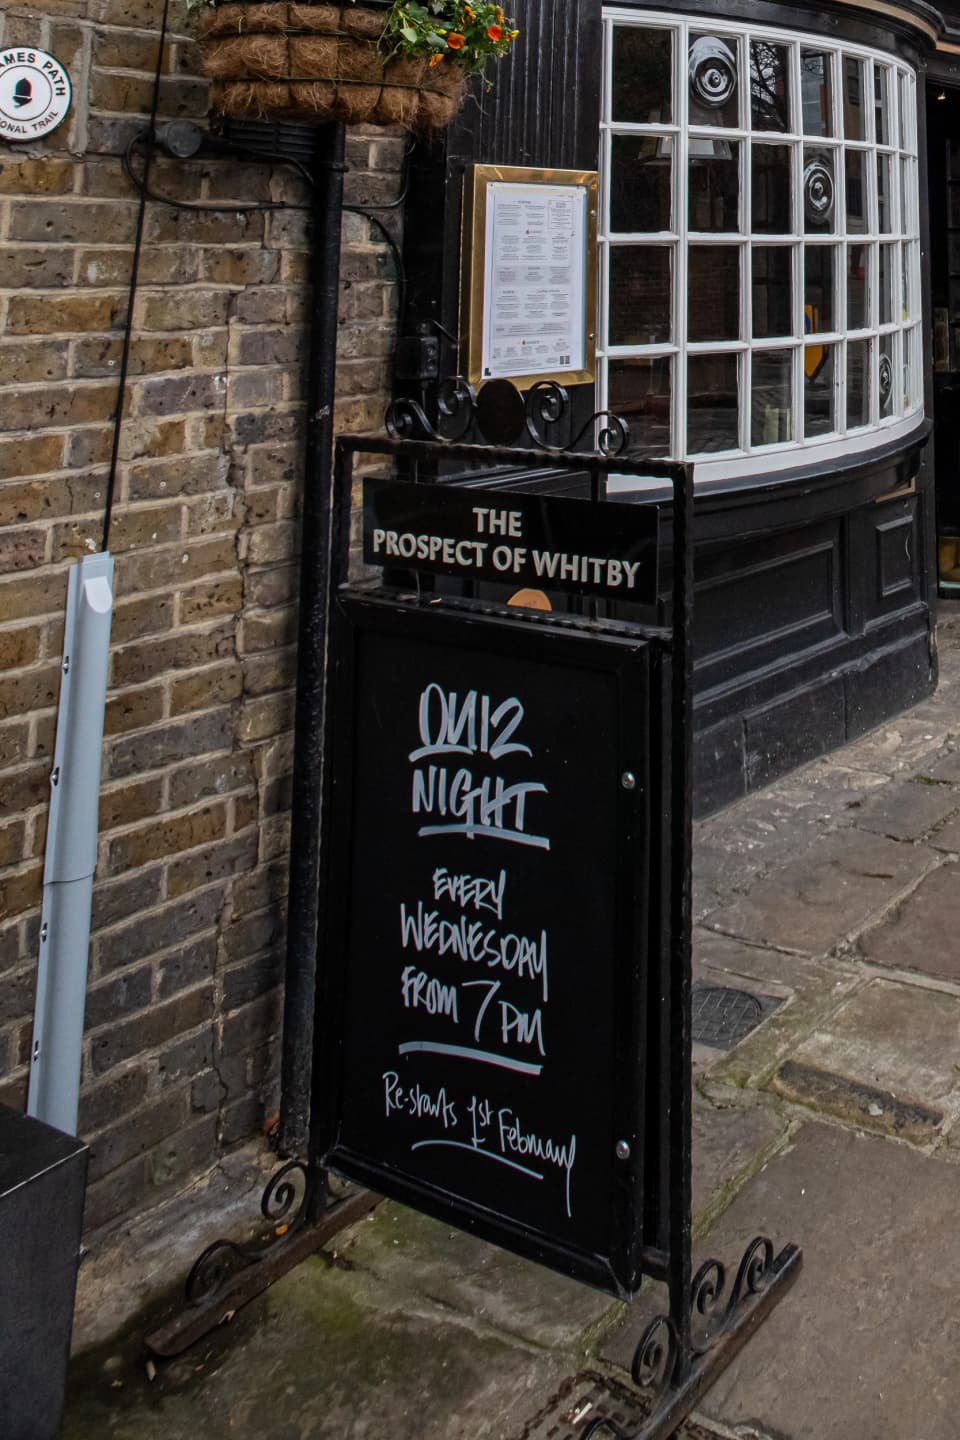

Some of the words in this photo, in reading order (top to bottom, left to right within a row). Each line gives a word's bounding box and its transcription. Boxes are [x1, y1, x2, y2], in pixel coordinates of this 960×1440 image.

[42, 61, 66, 96] PATH
[31, 111, 59, 131] TRAIL
[472, 507, 523, 538] THE
[373, 529, 488, 568] PROSPECT
[492, 545, 527, 574] OF
[532, 550, 641, 589] WHITBY
[412, 765, 549, 840] NIGHT
[432, 867, 506, 921] EVERY
[400, 900, 548, 1003] WEDNESDAY
[401, 965, 460, 1024] FROM
[462, 980, 501, 1043] 7
[498, 1000, 547, 1057] PM
[467, 1095, 495, 1148] 1st
